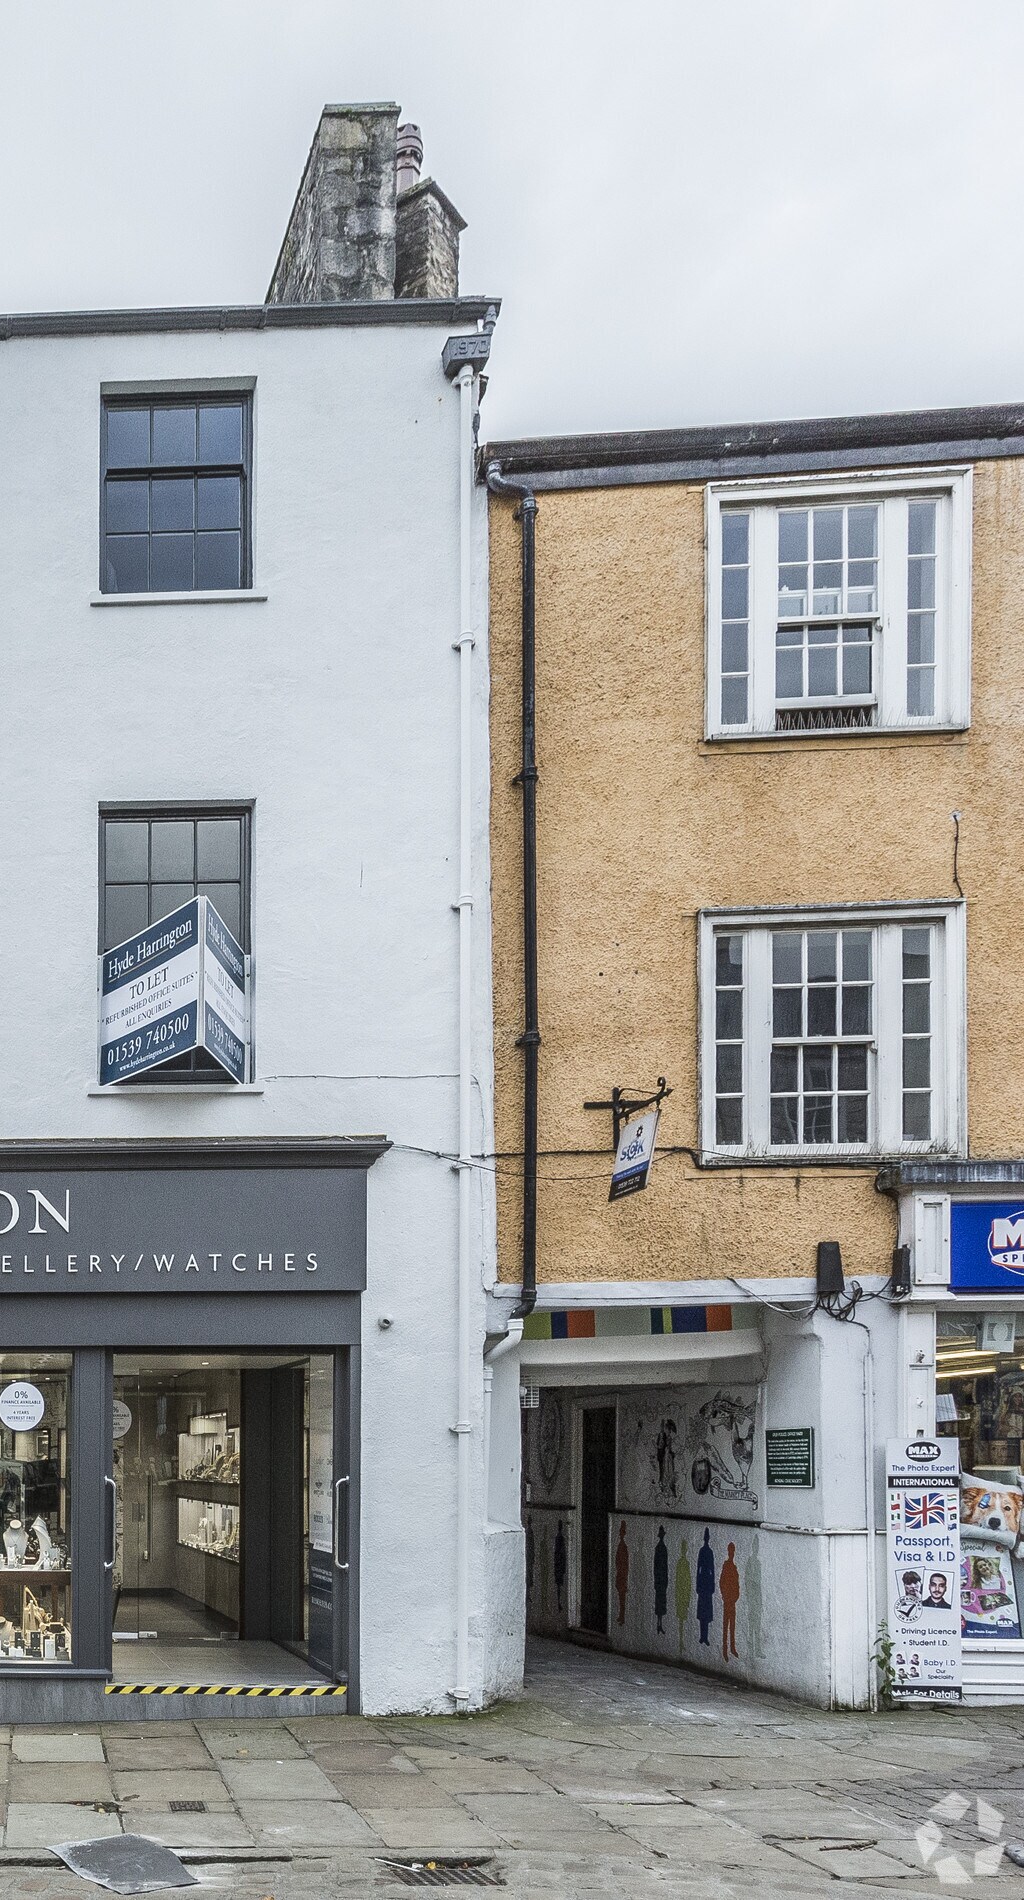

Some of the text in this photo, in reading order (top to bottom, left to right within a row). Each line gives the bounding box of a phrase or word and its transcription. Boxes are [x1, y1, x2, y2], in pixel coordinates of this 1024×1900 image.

[108, 919, 193, 978] Hyde Harrington
[130, 967, 170, 1000] TO LET
[105, 974, 194, 1025] REFURBISHED OFFICE SUITES
[125, 999, 172, 1029] ALL ENQUIRIES
[107, 1035, 142, 1065] 01539
[146, 1013, 189, 1050] 740500
[14, 1391, 28, 1399] 0%
[908, 1446, 939, 1455] MAX
[932, 1465, 955, 1473] Expert
[893, 1478, 955, 1487] INTERNATIONAL
[895, 1535, 954, 1548] Passport,
[894, 1551, 955, 1562] Visa & I.D
[901, 1628, 926, 1636] Driving
[929, 1690, 960, 1699] Details
